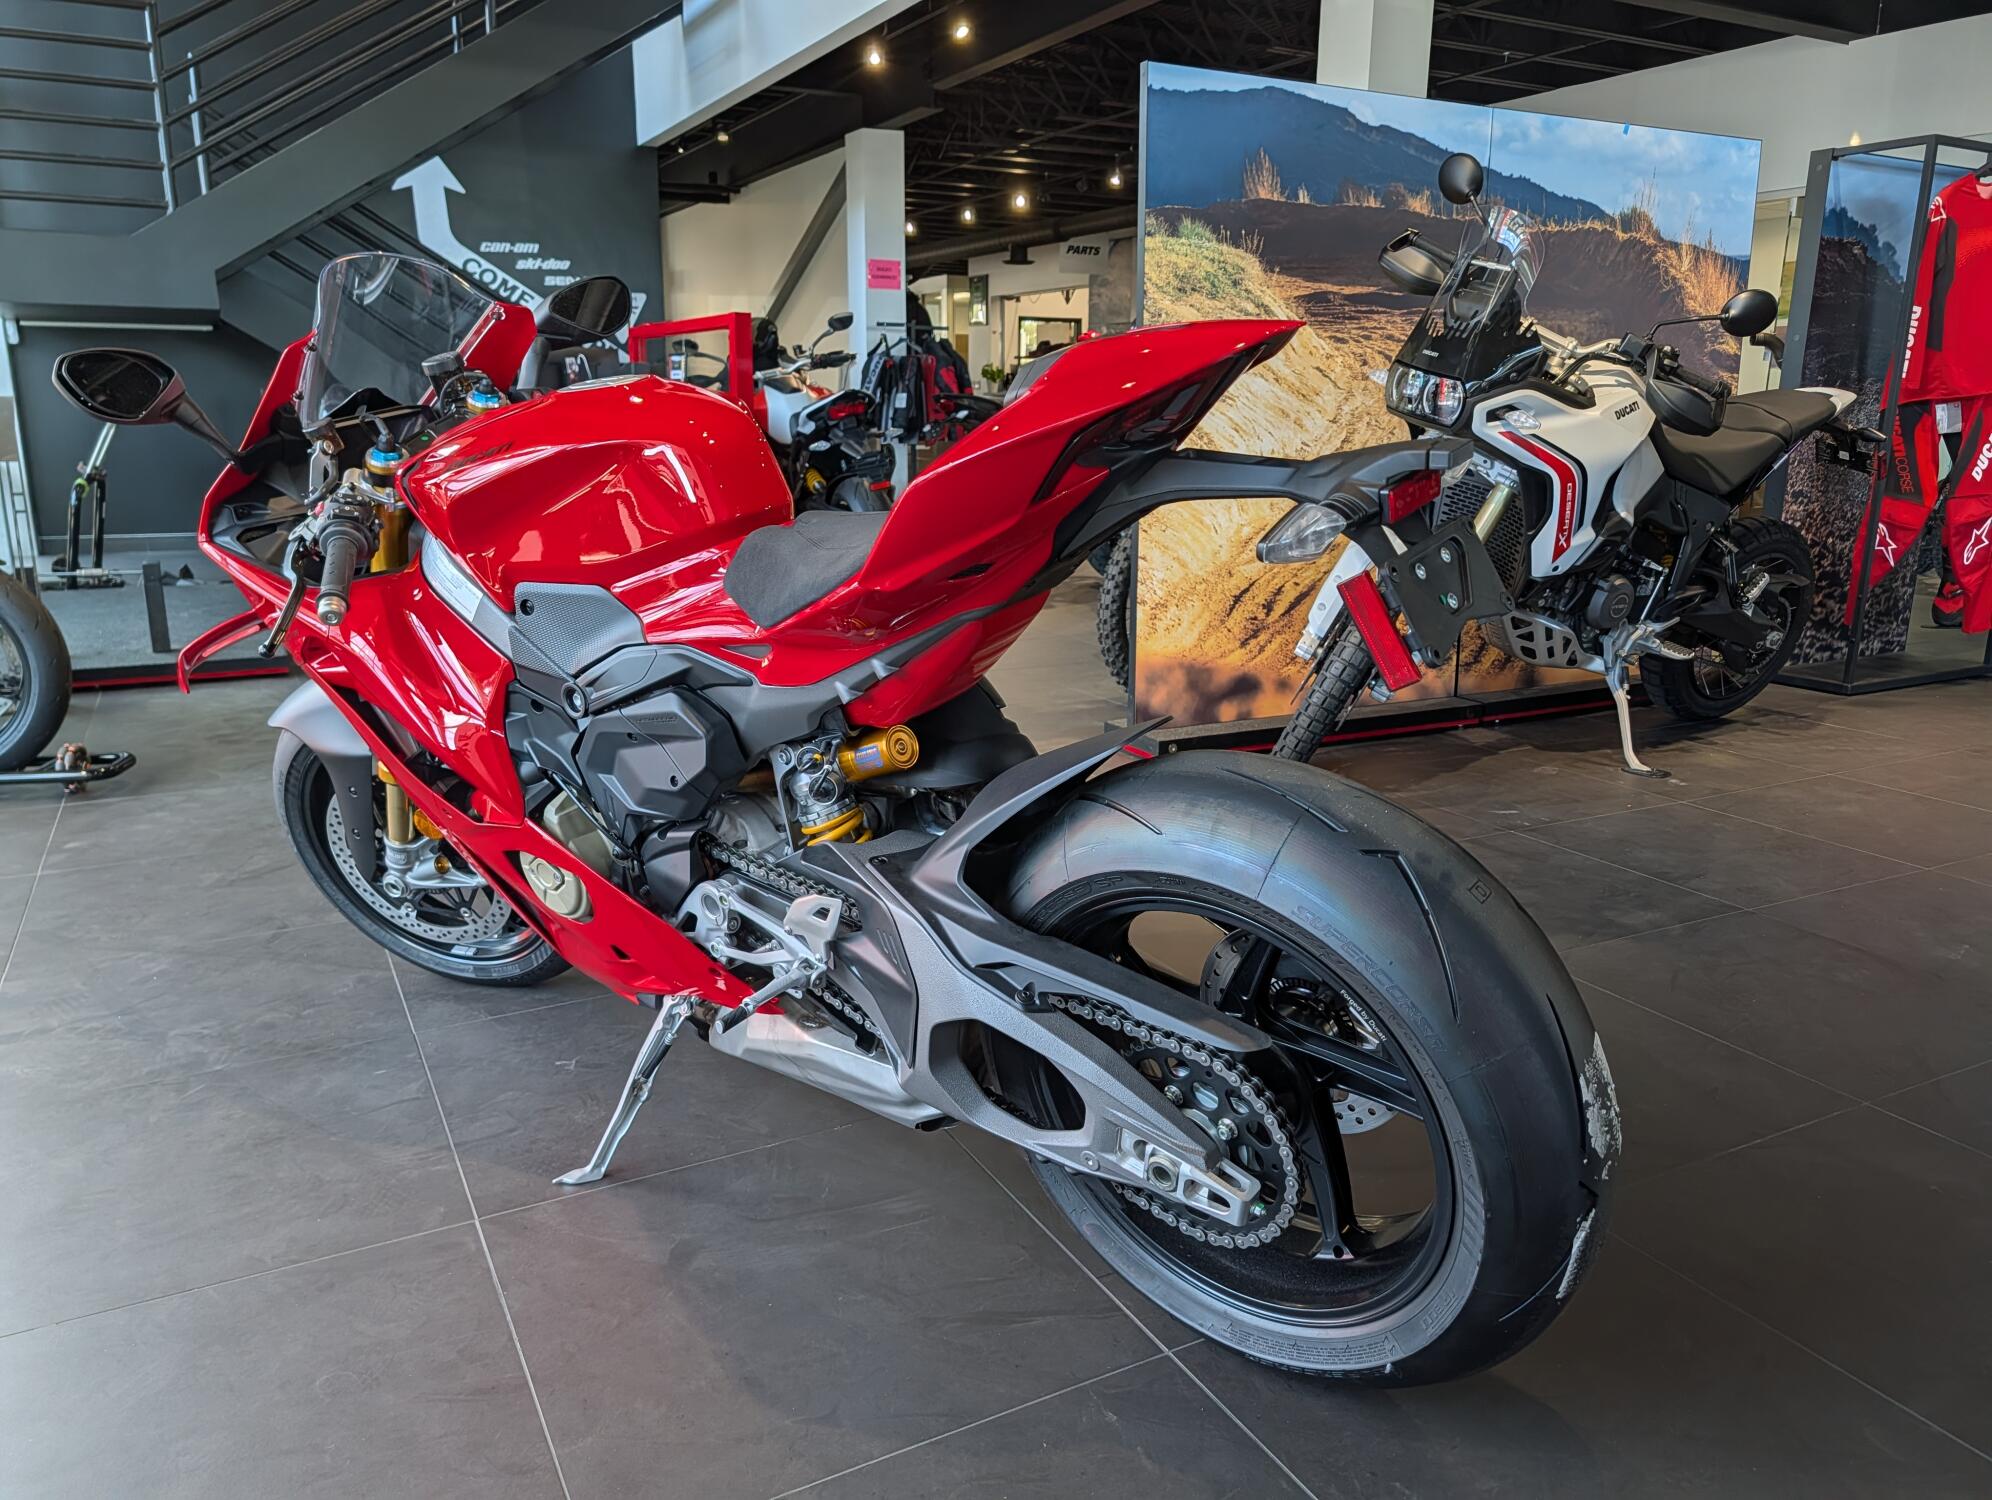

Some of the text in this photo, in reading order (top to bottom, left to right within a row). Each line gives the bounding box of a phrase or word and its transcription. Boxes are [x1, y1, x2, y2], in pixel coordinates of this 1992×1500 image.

[515, 257, 571, 270] ski-doo
[1066, 245, 1101, 256] PARTS
[462, 258, 535, 304] COME
[1614, 401, 1640, 420] DUCATI
[1895, 456, 1914, 494] CORSE
[1340, 989, 1387, 1042] Forged by Ducati
